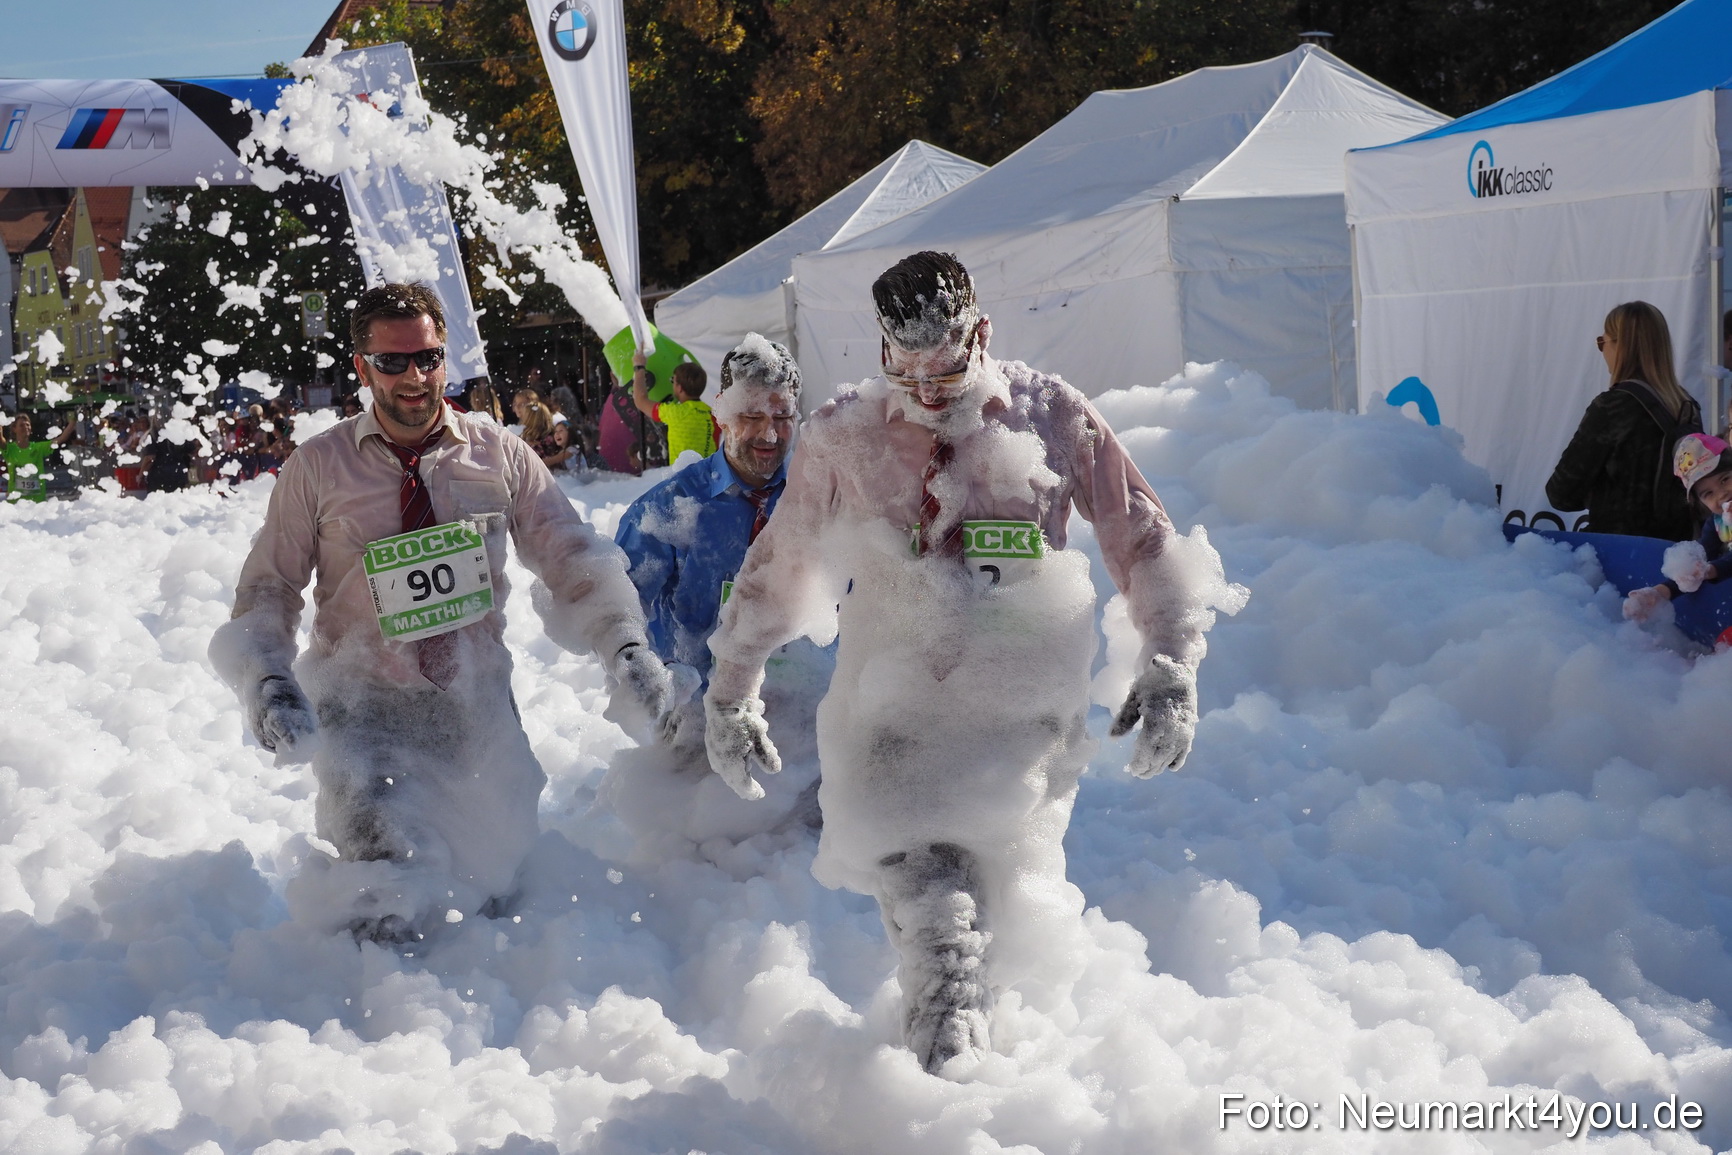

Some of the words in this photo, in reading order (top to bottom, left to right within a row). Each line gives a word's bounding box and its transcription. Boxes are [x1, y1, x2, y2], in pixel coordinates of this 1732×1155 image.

[1504, 162, 1553, 195] classic
[373, 527, 472, 568] BOCK
[406, 563, 456, 602] 90
[394, 596, 482, 632] MATTHIAS
